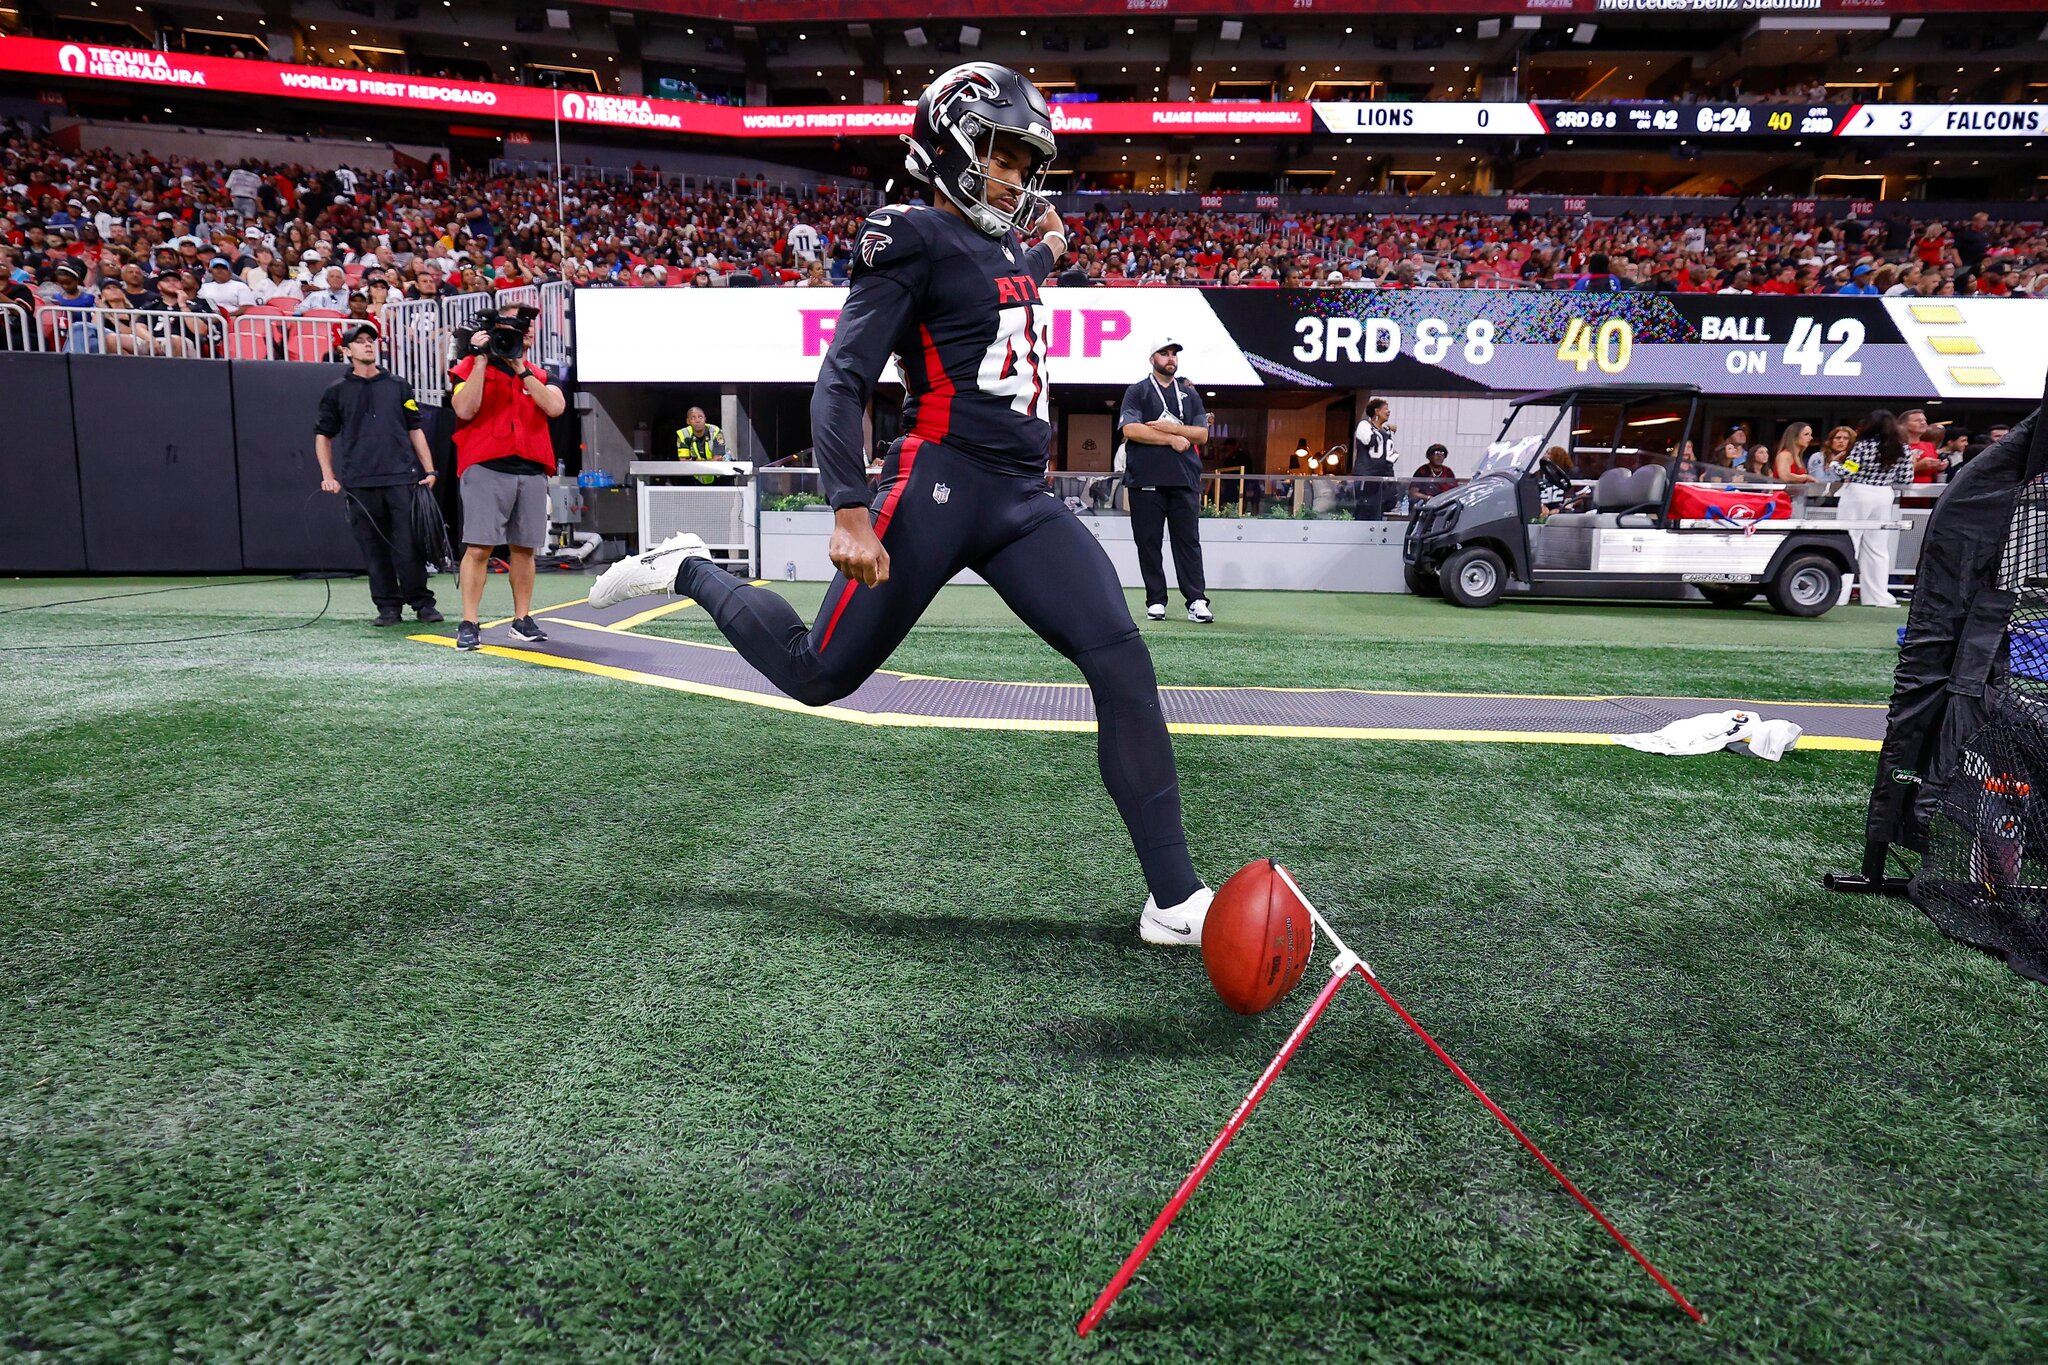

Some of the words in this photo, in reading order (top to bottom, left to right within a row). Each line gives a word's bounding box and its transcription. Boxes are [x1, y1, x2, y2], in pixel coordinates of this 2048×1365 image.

[87, 47, 168, 68] TEQUILA
[88, 61, 206, 85] HERRADURA
[280, 72, 358, 93] WORLD'S
[360, 79, 406, 97] FIRST
[408, 84, 496, 105] REPOSADO
[586, 95, 651, 113] TEQUILA
[587, 108, 682, 128] HERRADURA
[743, 114, 804, 128] WORLD'S
[806, 114, 845, 127] FIRST
[1152, 111, 1192, 123] PLEASE
[1194, 111, 1227, 123] DRINK
[1228, 111, 1302, 123] RESPONSIBLY.
[1357, 108, 1413, 126] LIONS
[1477, 109, 1489, 127] 0
[1555, 111, 1589, 127] 3RD
[1590, 111, 1604, 128] &
[1605, 111, 1617, 128] 8
[1629, 110, 1651, 119] BALL
[1652, 110, 1678, 130] 42
[1696, 107, 1751, 132] 6:24
[1767, 112, 1792, 130] 40
[1899, 110, 1913, 130] 3
[1946, 111, 2039, 130] FALCONS
[1800, 117, 1833, 133] 2ND
[509, 132, 530, 143] 106
[1201, 196, 1222, 206] 108C
[1256, 196, 1279, 207] 109C
[1564, 199, 1586, 210] 110C
[796, 235, 810, 250] 11
[1700, 316, 1771, 342] BALL
[1293, 316, 1400, 363] 3RD
[1413, 318, 1453, 365] &
[1464, 318, 1495, 365] 8
[1557, 318, 1633, 373] 40
[1725, 350, 1767, 374] ON
[1782, 316, 1866, 376] 42
[1682, 573, 1728, 582] CARRYALL
[1728, 573, 1751, 582] 700
